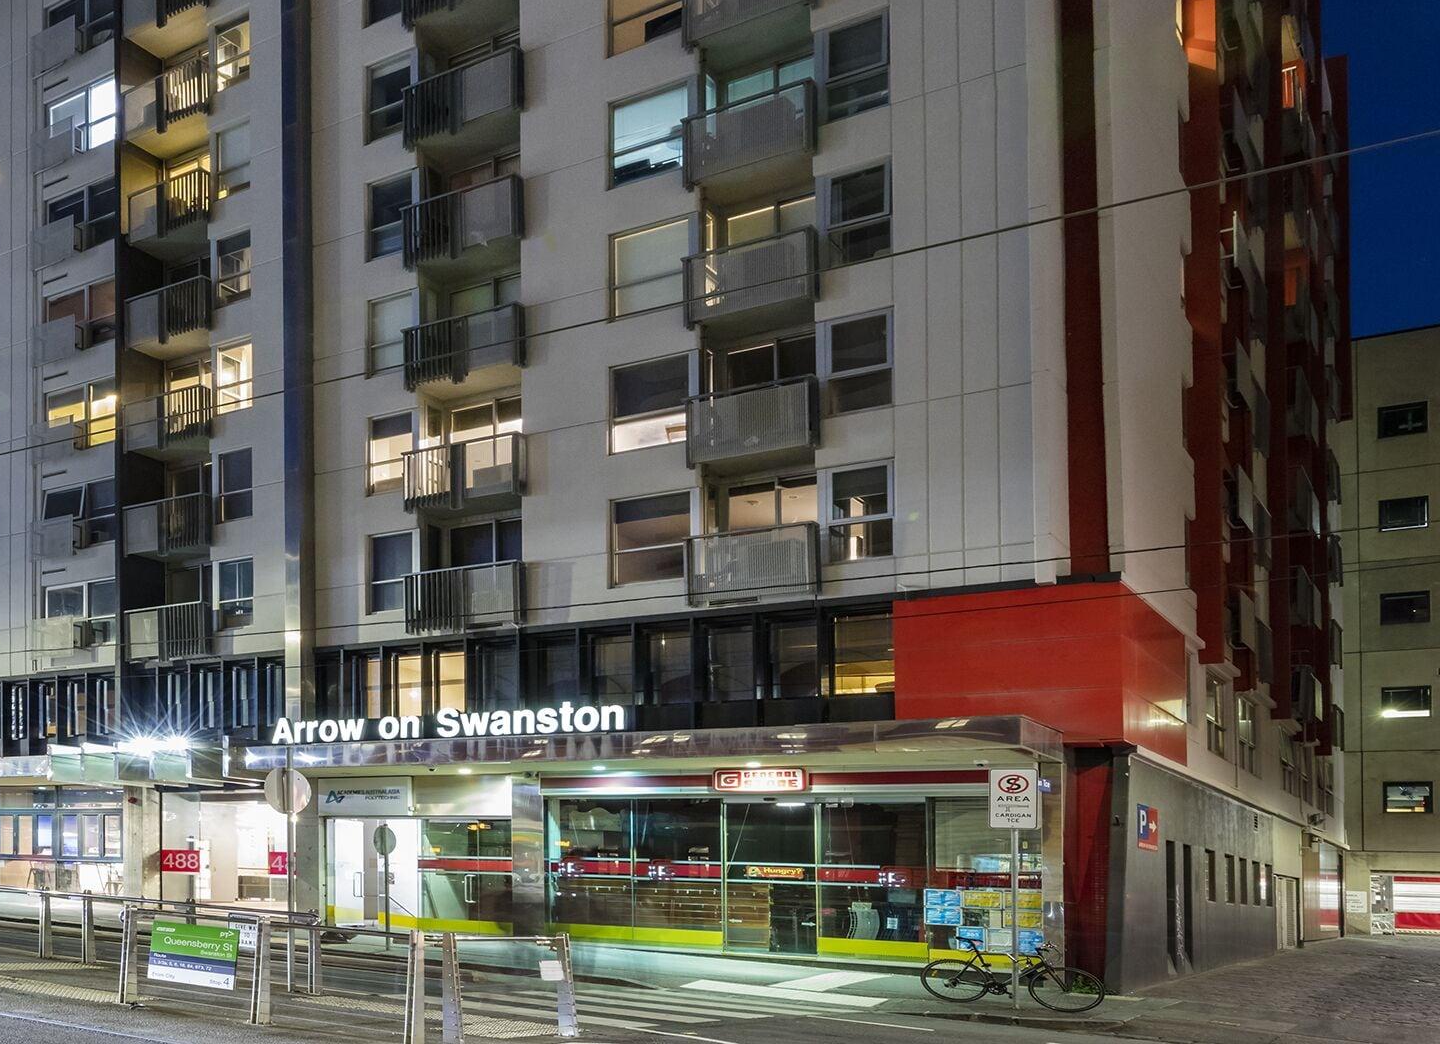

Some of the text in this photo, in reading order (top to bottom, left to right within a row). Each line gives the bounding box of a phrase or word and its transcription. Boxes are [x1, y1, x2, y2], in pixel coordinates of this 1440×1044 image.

[272, 701, 625, 744] Arrow on Swanston
[1140, 809, 1147, 834] P
[163, 853, 199, 869] 488
[763, 867, 802, 875] Hungry?
[164, 936, 233, 952] Queensberry St
[223, 977, 230, 988] 4
